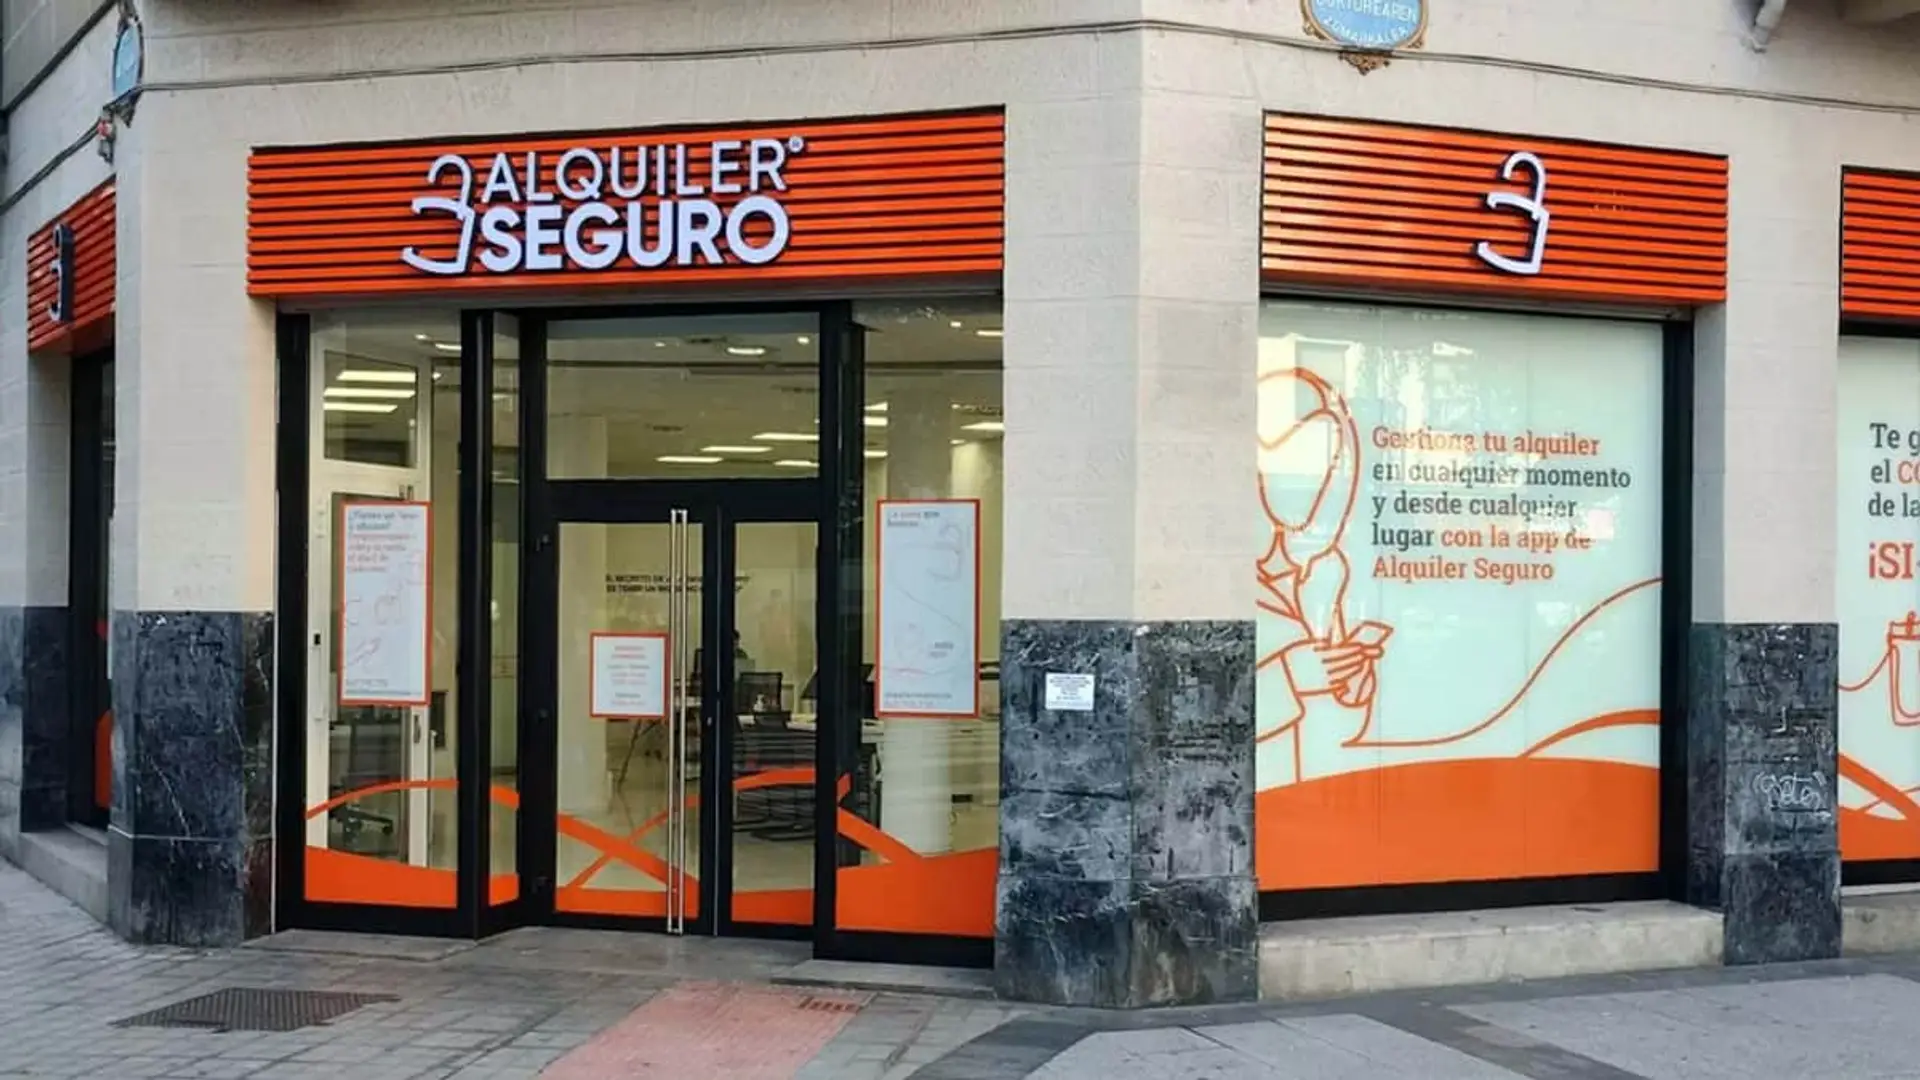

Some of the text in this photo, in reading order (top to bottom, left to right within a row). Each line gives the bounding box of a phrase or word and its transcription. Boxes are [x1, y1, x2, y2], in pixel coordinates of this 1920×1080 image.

[481, 138, 786, 203] ALQUILER
[478, 195, 789, 273] SEGURO
[1372, 426, 1600, 459] Gestiona tu alquiler
[1869, 422, 1900, 449] Te
[1372, 460, 1631, 488] en cualquier momento
[1870, 458, 1891, 483] el
[1371, 490, 1578, 522] y desde cualquier
[1868, 491, 1895, 517] de
[1371, 522, 1590, 553] lugar con la app de
[1372, 555, 1554, 585] Alquiler Seguro
